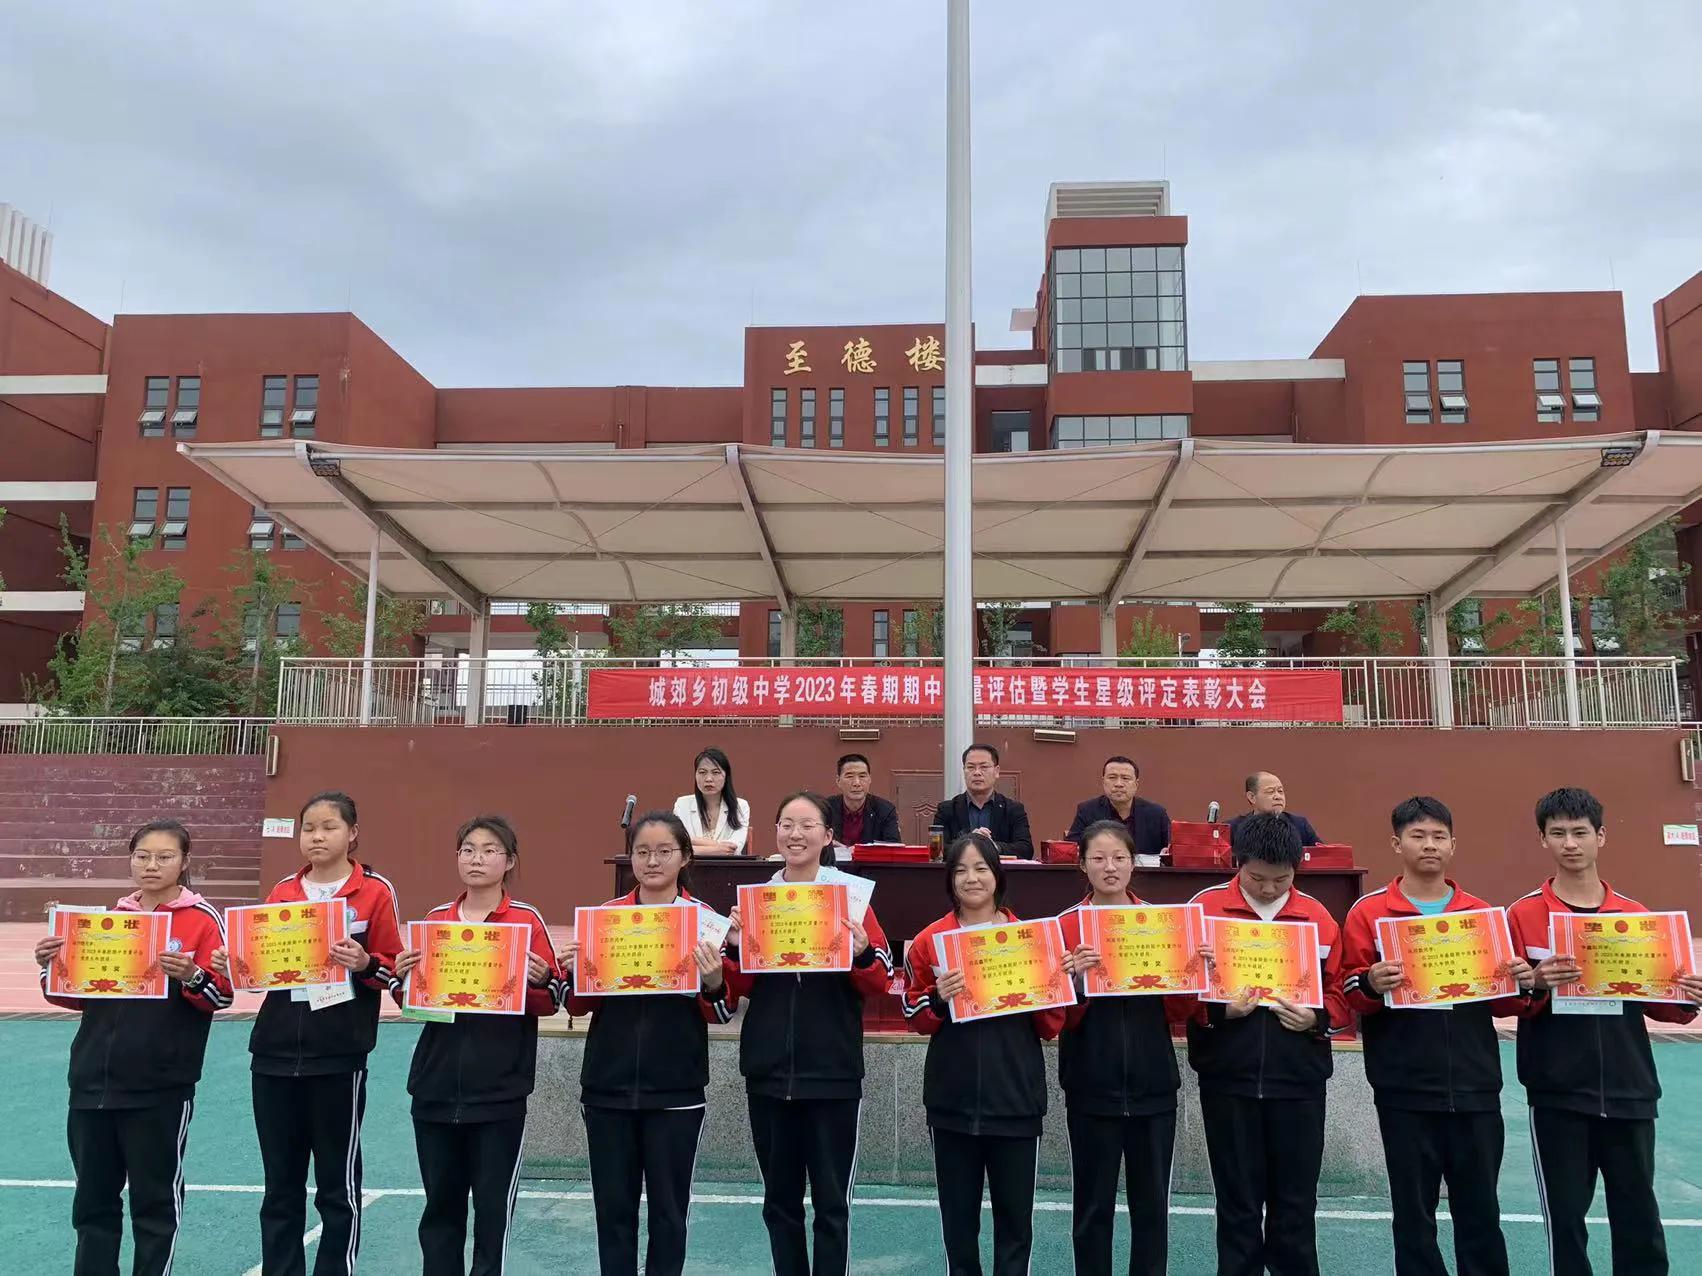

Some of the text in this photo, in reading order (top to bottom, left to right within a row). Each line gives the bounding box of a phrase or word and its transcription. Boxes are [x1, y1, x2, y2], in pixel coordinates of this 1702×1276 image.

[784, 336, 945, 375] 至德楼
[649, 675, 1266, 709] 城郊乡初级中学2023年春期期中量评估暨学生星级评定表彰大会
